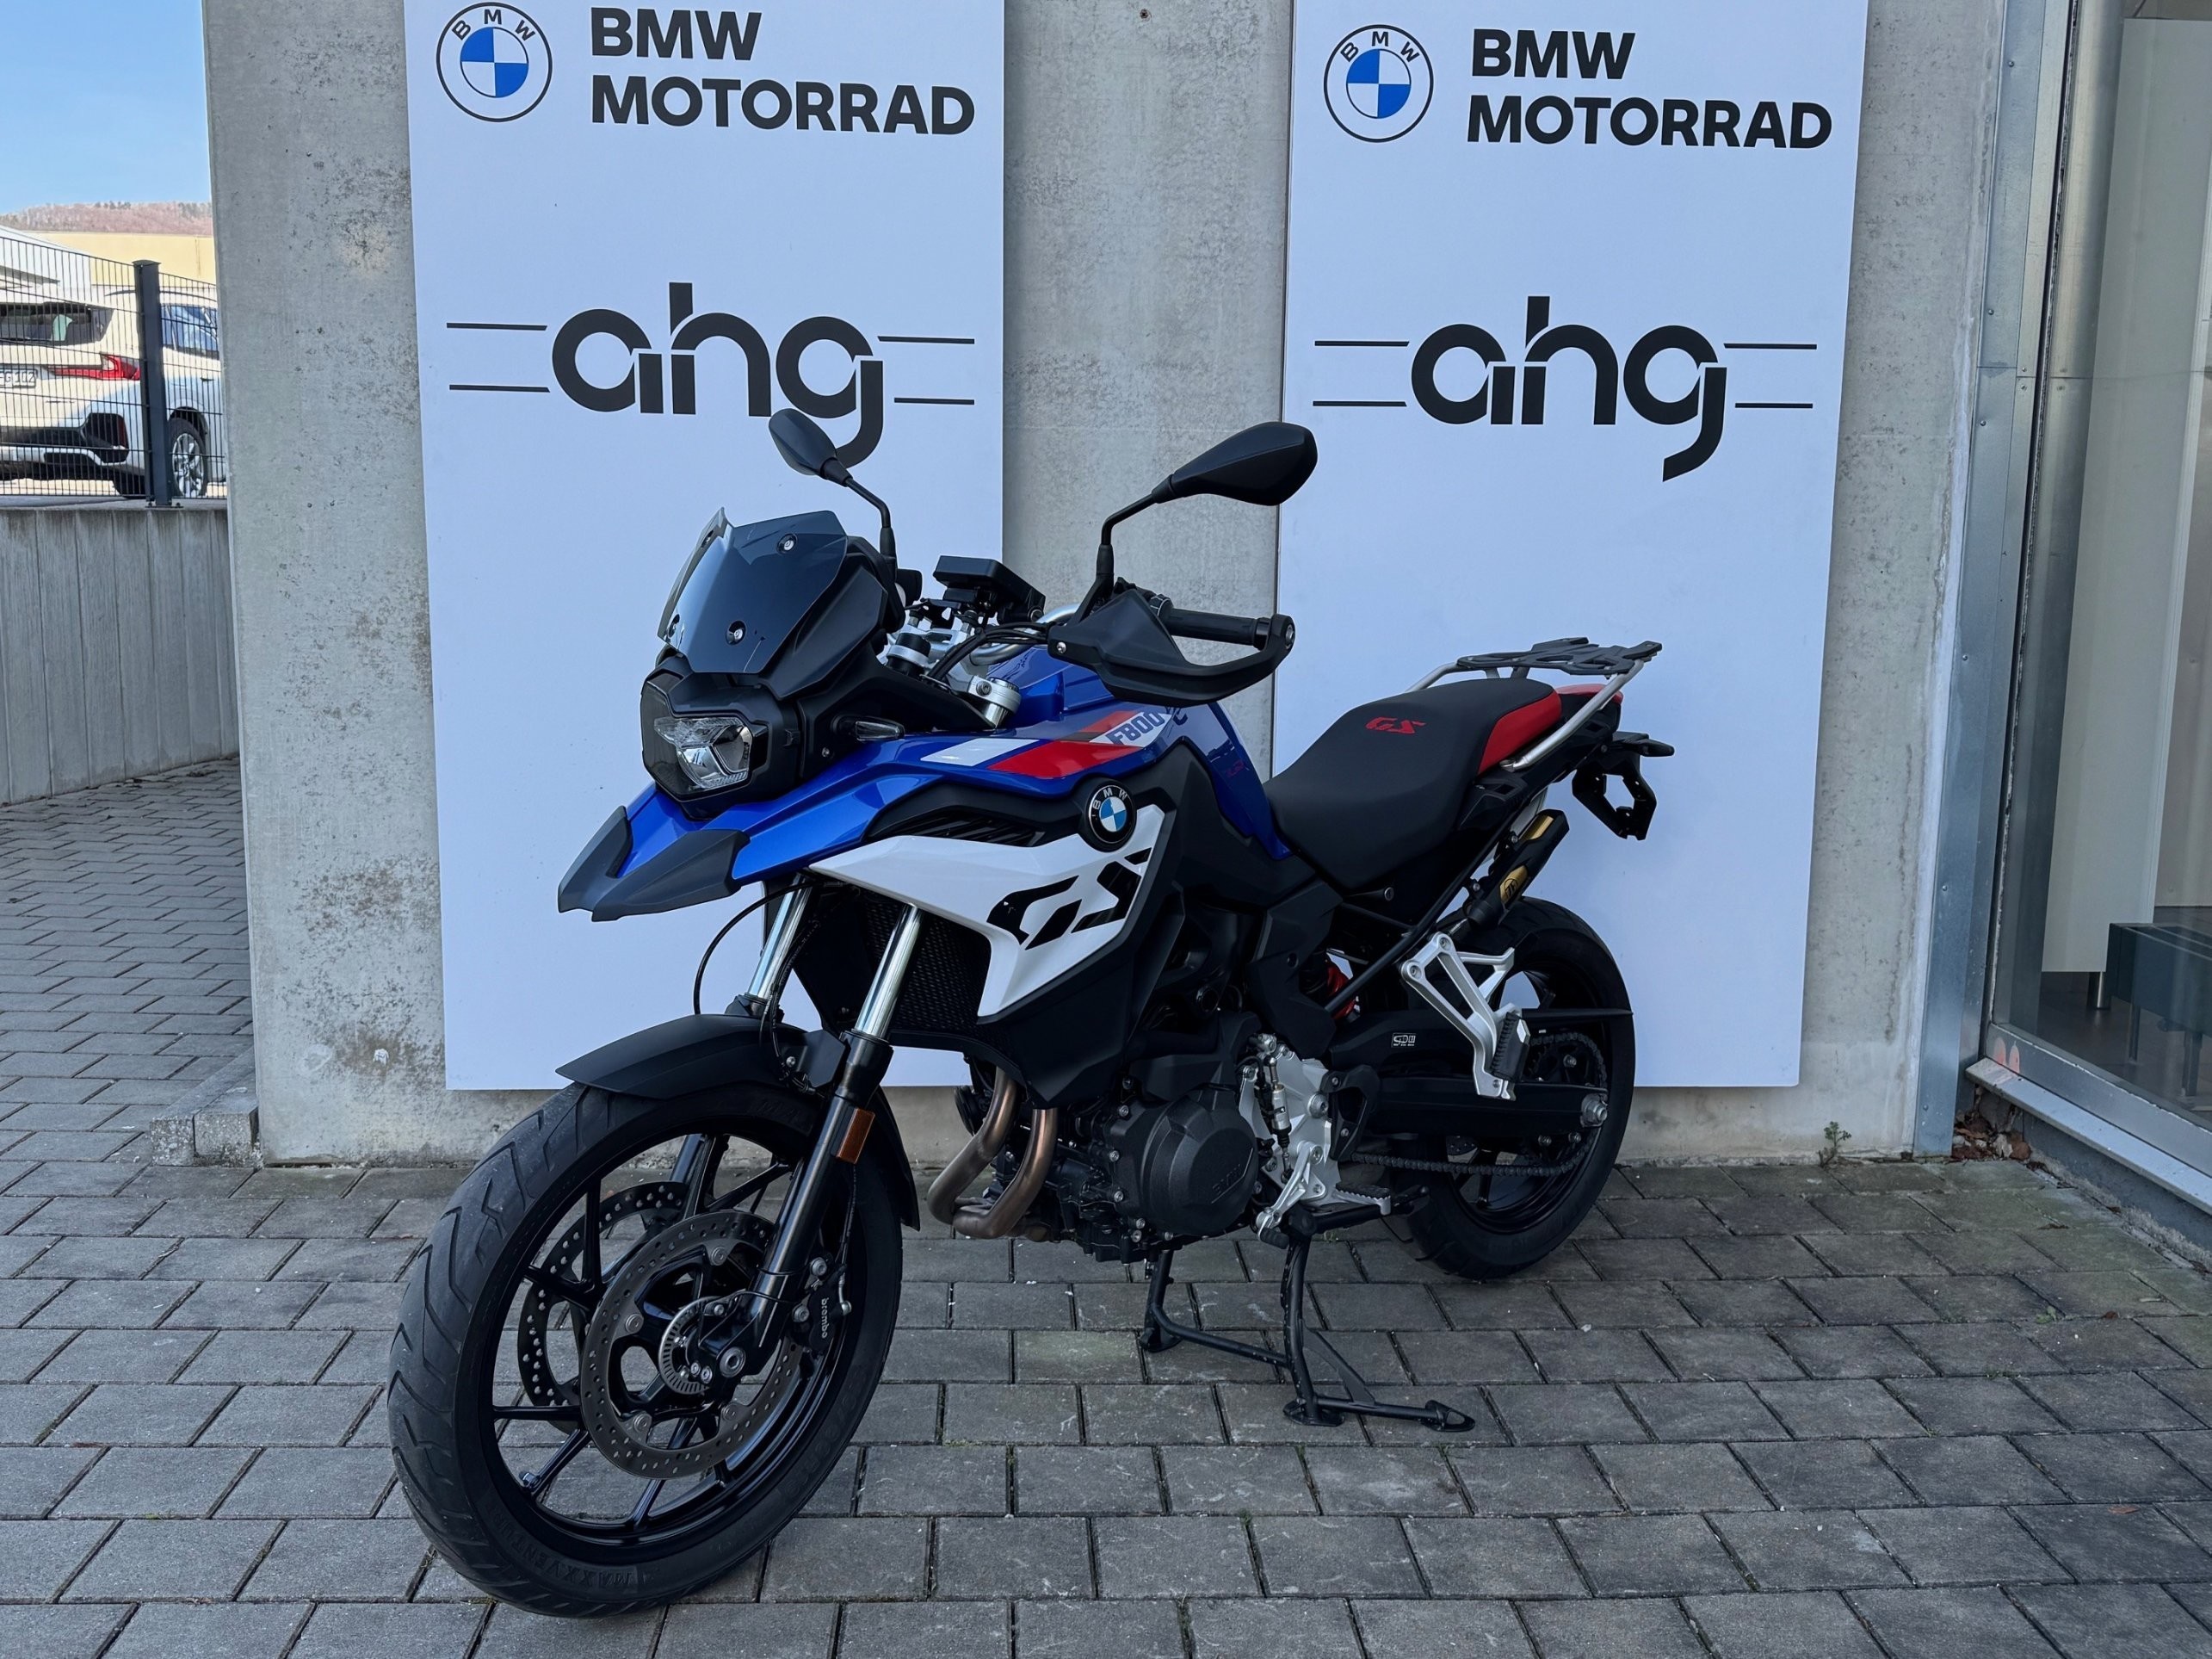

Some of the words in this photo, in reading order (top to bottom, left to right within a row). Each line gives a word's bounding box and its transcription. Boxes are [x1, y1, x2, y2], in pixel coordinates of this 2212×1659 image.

[454, 8, 535, 42] BMW
[591, 7, 763, 61] BMW
[1340, 30, 1420, 63] BMW
[1473, 28, 1636, 80] BMW
[591, 74, 975, 135] MOTORRAD
[1467, 95, 1832, 149] MOTORRAD
[552, 282, 884, 470] ahg
[1411, 295, 1727, 483] ahg
[1106, 711, 1165, 746] F800
[1364, 716, 1428, 734] GS
[1092, 787, 1128, 810] BMW
[820, 1297, 831, 1340] brembo
